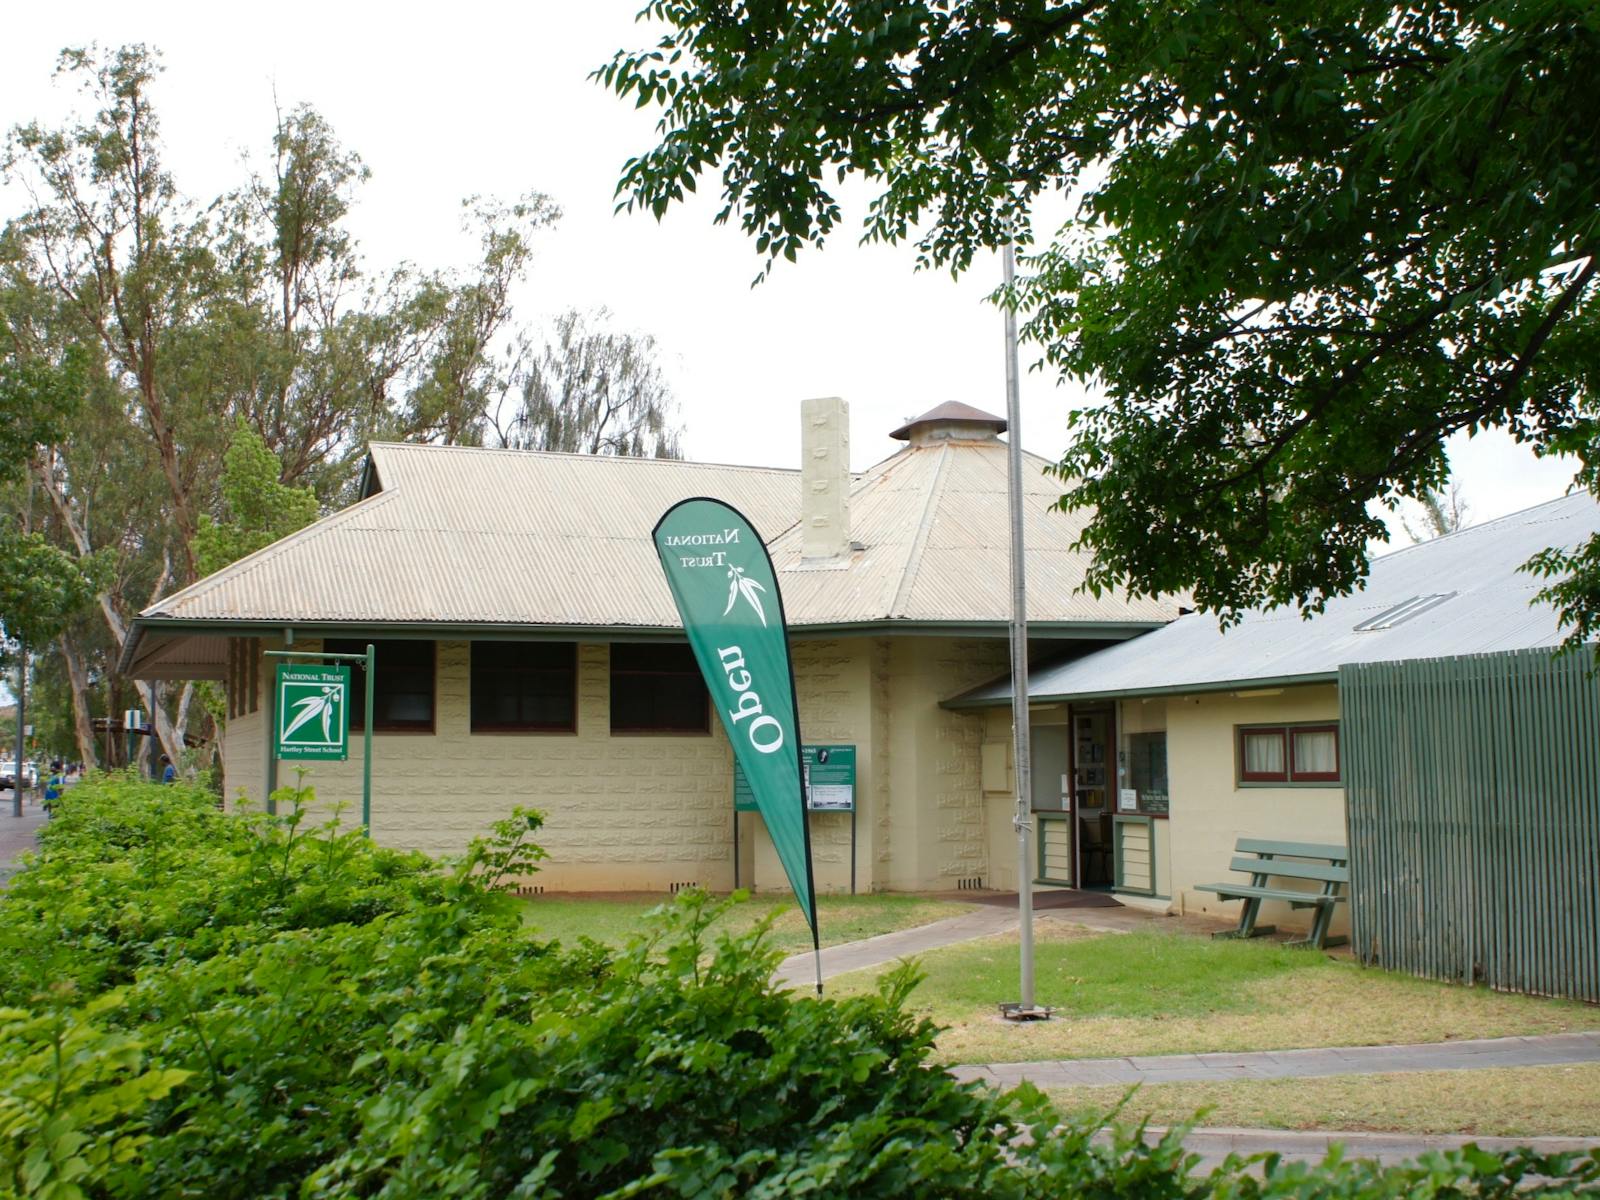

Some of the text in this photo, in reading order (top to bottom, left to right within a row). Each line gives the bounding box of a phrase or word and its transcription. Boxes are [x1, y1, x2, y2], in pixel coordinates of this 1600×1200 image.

[282, 672, 344, 682] NATIONAL TRUST
[280, 746, 302, 754] Hartley
